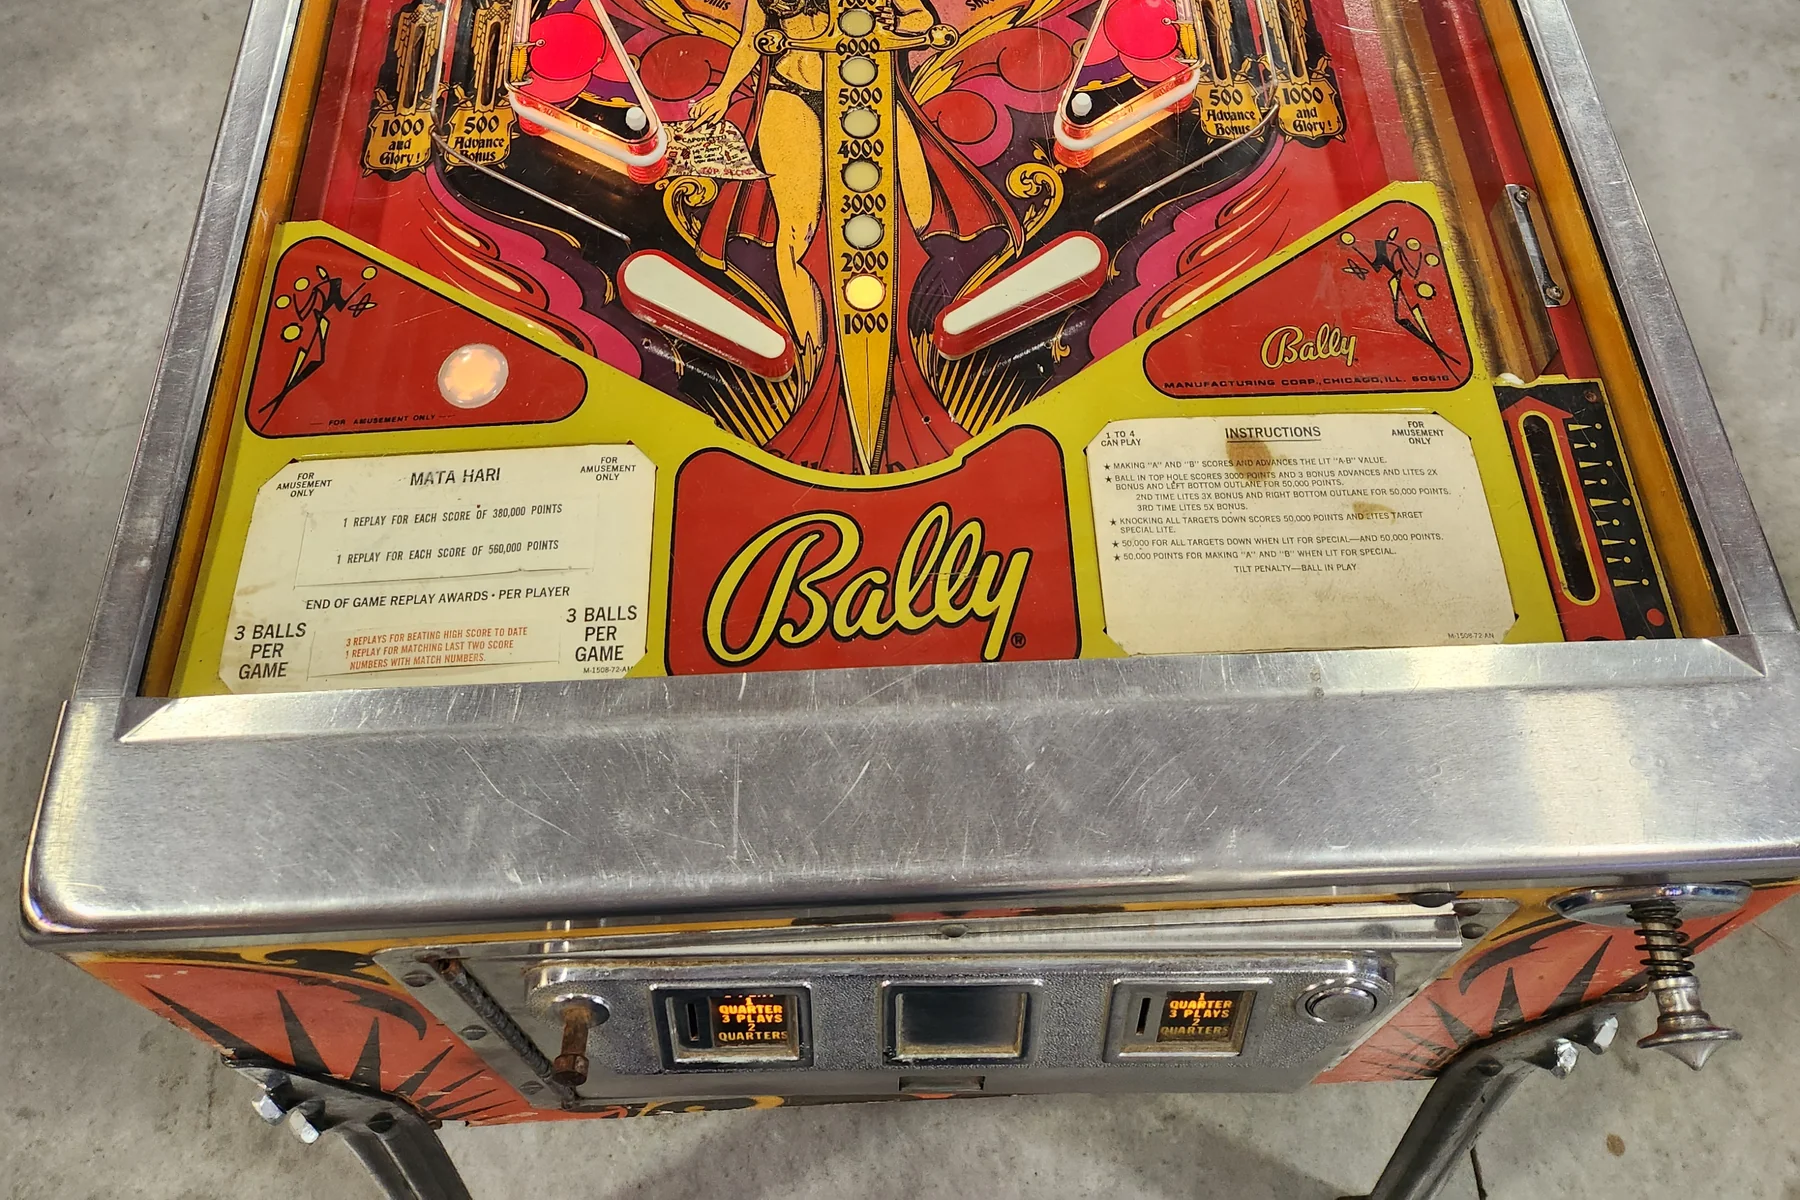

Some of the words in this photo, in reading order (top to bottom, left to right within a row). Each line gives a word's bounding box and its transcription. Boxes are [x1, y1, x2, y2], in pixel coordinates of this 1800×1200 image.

[836, 37, 880, 56] 6000
[838, 87, 883, 106] 5000
[1208, 88, 1244, 107] 500
[1281, 86, 1325, 106] 1000
[1205, 107, 1256, 121] Advance
[1295, 106, 1318, 120] and
[381, 118, 426, 138] 1000
[463, 115, 501, 135] 500
[1214, 121, 1251, 136] Bonus
[388, 139, 412, 151] and
[453, 136, 505, 151] Advance
[837, 138, 885, 158] 4000
[457, 149, 498, 164] Bonus
[840, 193, 887, 214] 3000
[840, 250, 889, 272] 2000
[843, 312, 889, 335] 1000
[1260, 323, 1358, 369] Bally
[1163, 379, 1276, 389] MANUFACTURING
[328, 418, 347, 427] FOR
[353, 415, 409, 426] AMUSEMENT
[412, 413, 436, 422] ONLY
[1407, 420, 1425, 429] FOR
[1113, 430, 1127, 439] TO
[1129, 430, 1136, 438] 4
[1225, 426, 1322, 440] INSTRUCTIONS
[1391, 428, 1445, 438] AMUSEMENT
[1100, 439, 1119, 447] CAN
[1120, 438, 1142, 447] PLAY
[1408, 437, 1432, 446] ONLY
[600, 456, 618, 464] FOR
[1113, 461, 1146, 470] MAKING
[1164, 460, 1183, 469] AND
[1201, 459, 1234, 468] SCORES
[1235, 459, 1253, 468] AND
[1255, 458, 1299, 467] ADVANCES
[1299, 457, 1317, 466] THE
[1318, 457, 1331, 466] LIT
[1358, 456, 1387, 465] VALUE.
[297, 471, 315, 480] FOR
[580, 464, 637, 474] AMUSEMENT
[409, 471, 456, 487] MATA
[462, 467, 500, 484] HARI
[595, 473, 620, 481] ONLY
[275, 479, 333, 491] AMUSEMENT
[290, 489, 315, 498] ONLY
[353, 515, 386, 527] REPLAY
[391, 514, 409, 525] FOR
[414, 512, 437, 524] EACH
[442, 510, 471, 523] SCORE
[476, 509, 488, 520] OF
[492, 506, 526, 519] 380,000
[531, 503, 563, 516] POINTS
[702, 500, 1034, 667] Bally
[305, 599, 331, 610] END
[334, 597, 351, 609] OF
[352, 595, 388, 608] GAME
[390, 593, 436, 607] REPLAY
[438, 591, 489, 604] AWARDS
[498, 588, 522, 600] PER
[525, 586, 571, 599] PLAYER
[565, 607, 577, 623] 3
[583, 604, 638, 622] BALLS
[233, 625, 246, 641] 3
[252, 622, 307, 640] BALLS
[584, 625, 618, 642] PER
[250, 642, 284, 660] PER
[574, 645, 625, 663] GAME
[238, 661, 289, 680] GAME
[718, 1004, 783, 1015] QUARTER
[1169, 1000, 1233, 1010] QUARTER
[721, 1014, 731, 1023] 3
[736, 1014, 783, 1023] PLAYS
[1169, 1009, 1178, 1018] 3
[1183, 1009, 1230, 1019] PLAYS
[747, 1023, 756, 1032] 2
[718, 1031, 788, 1042] QUARTERS
